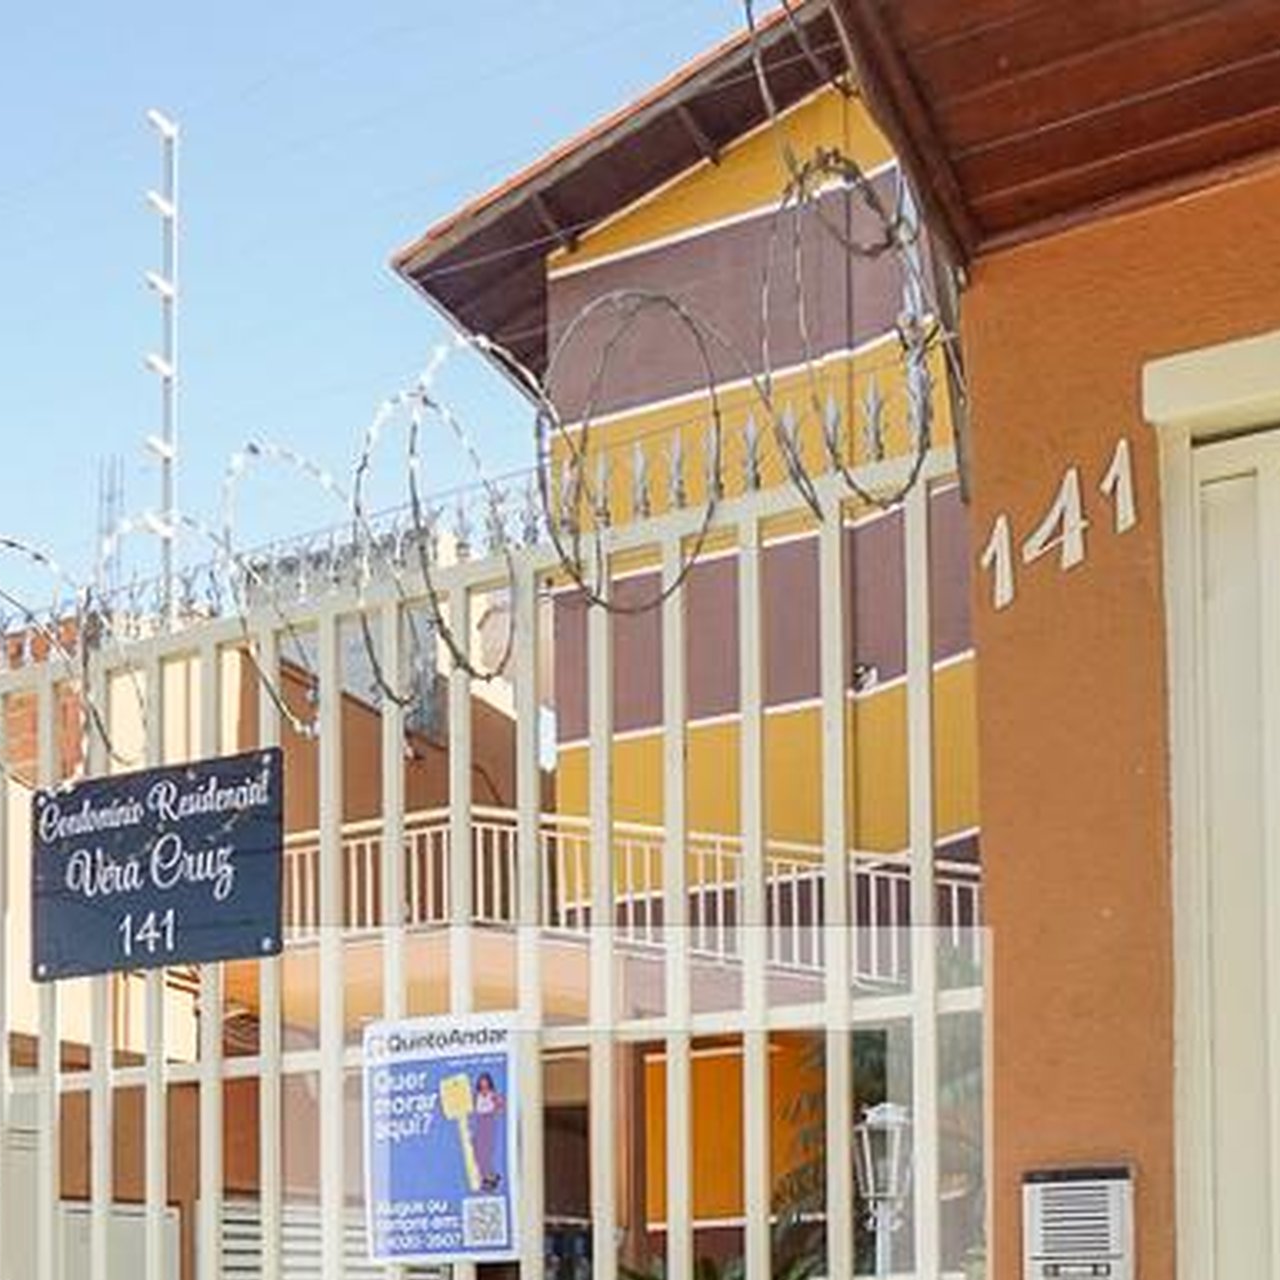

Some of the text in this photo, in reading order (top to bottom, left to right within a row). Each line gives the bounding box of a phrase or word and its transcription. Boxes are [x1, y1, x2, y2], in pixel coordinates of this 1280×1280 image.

[980, 437, 1136, 610] 141
[147, 769, 271, 822] Residencial
[65, 832, 235, 901] Vera Cruz
[119, 908, 174, 957] 141
[387, 1028, 508, 1053] QuintoAndar
[374, 1070, 427, 1094] Quer
[374, 1093, 438, 1116] morar
